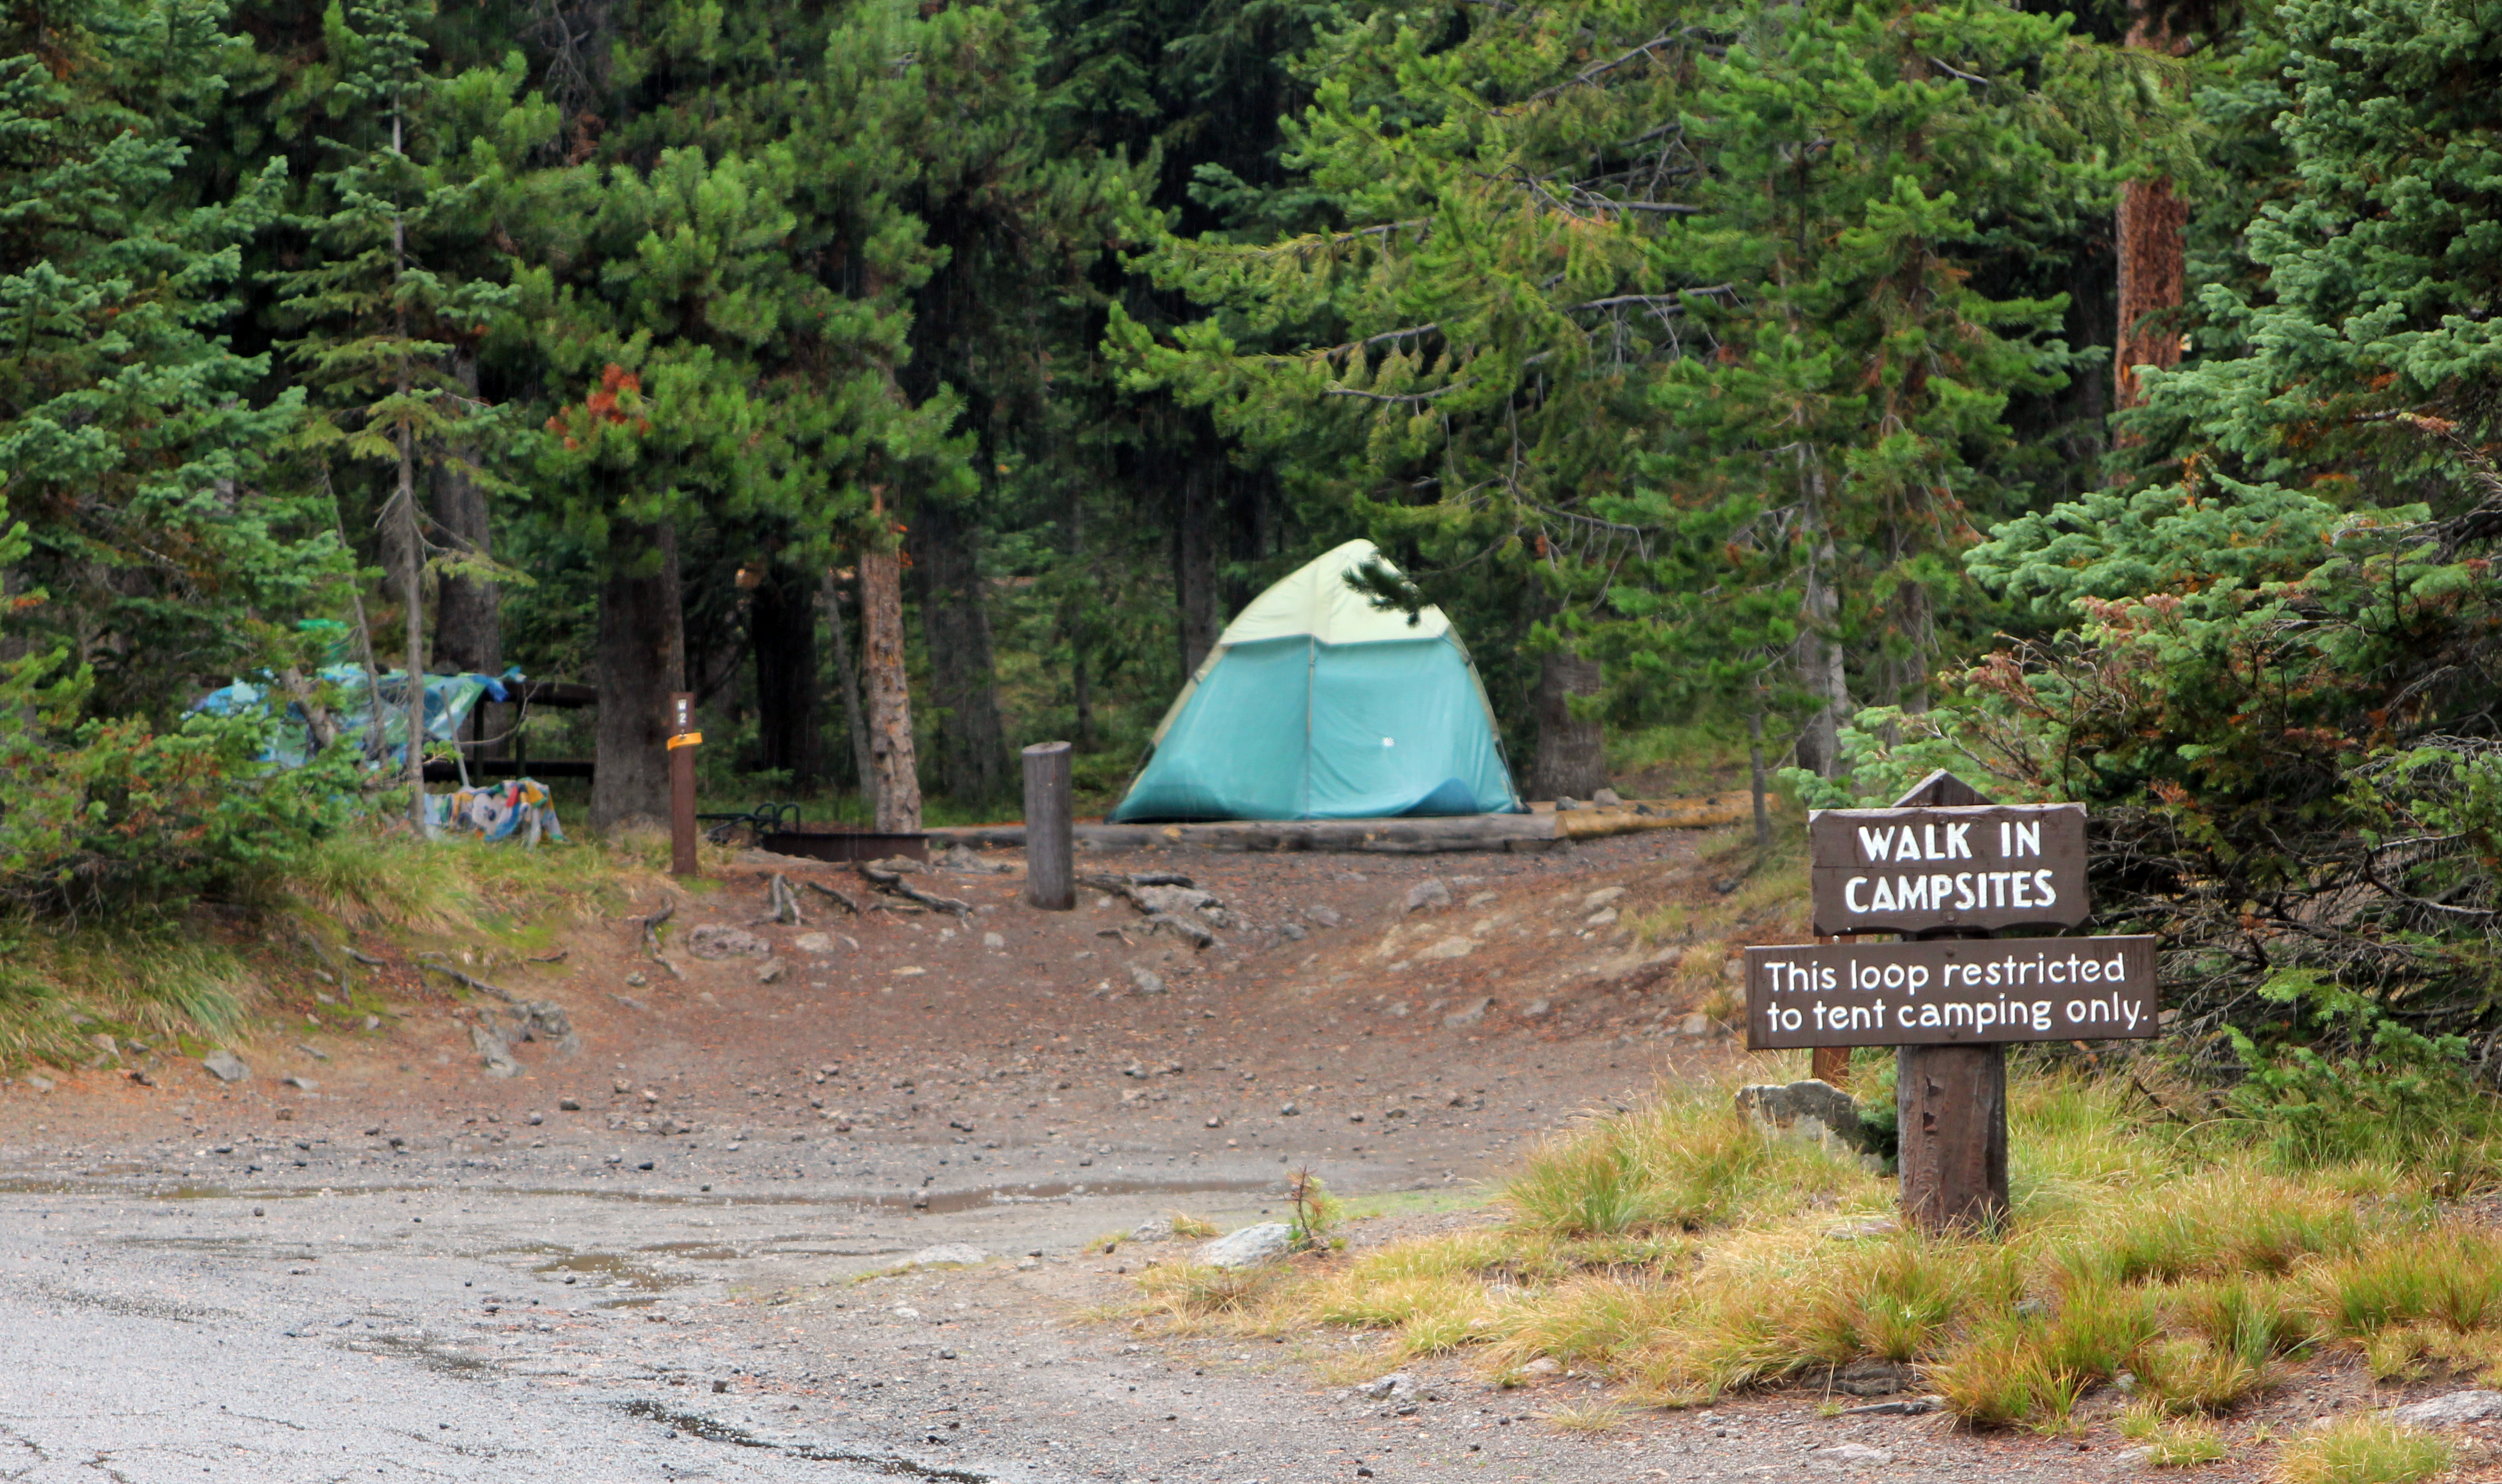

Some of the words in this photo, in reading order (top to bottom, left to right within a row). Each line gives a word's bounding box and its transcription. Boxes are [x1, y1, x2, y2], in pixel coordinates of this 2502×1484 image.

[678, 712, 686, 723] 2
[1858, 822, 1972, 862] WALK
[2001, 821, 2041, 857] IN
[1845, 869, 2056, 913] CAMPSITES
[1764, 961, 1837, 991] This
[1851, 959, 1929, 995] loop
[1944, 952, 2125, 987] restricted
[1767, 1002, 1802, 1032] to
[1813, 999, 1886, 1029] tent
[1898, 993, 2052, 1033] camping
[2066, 991, 2148, 1030] only.
